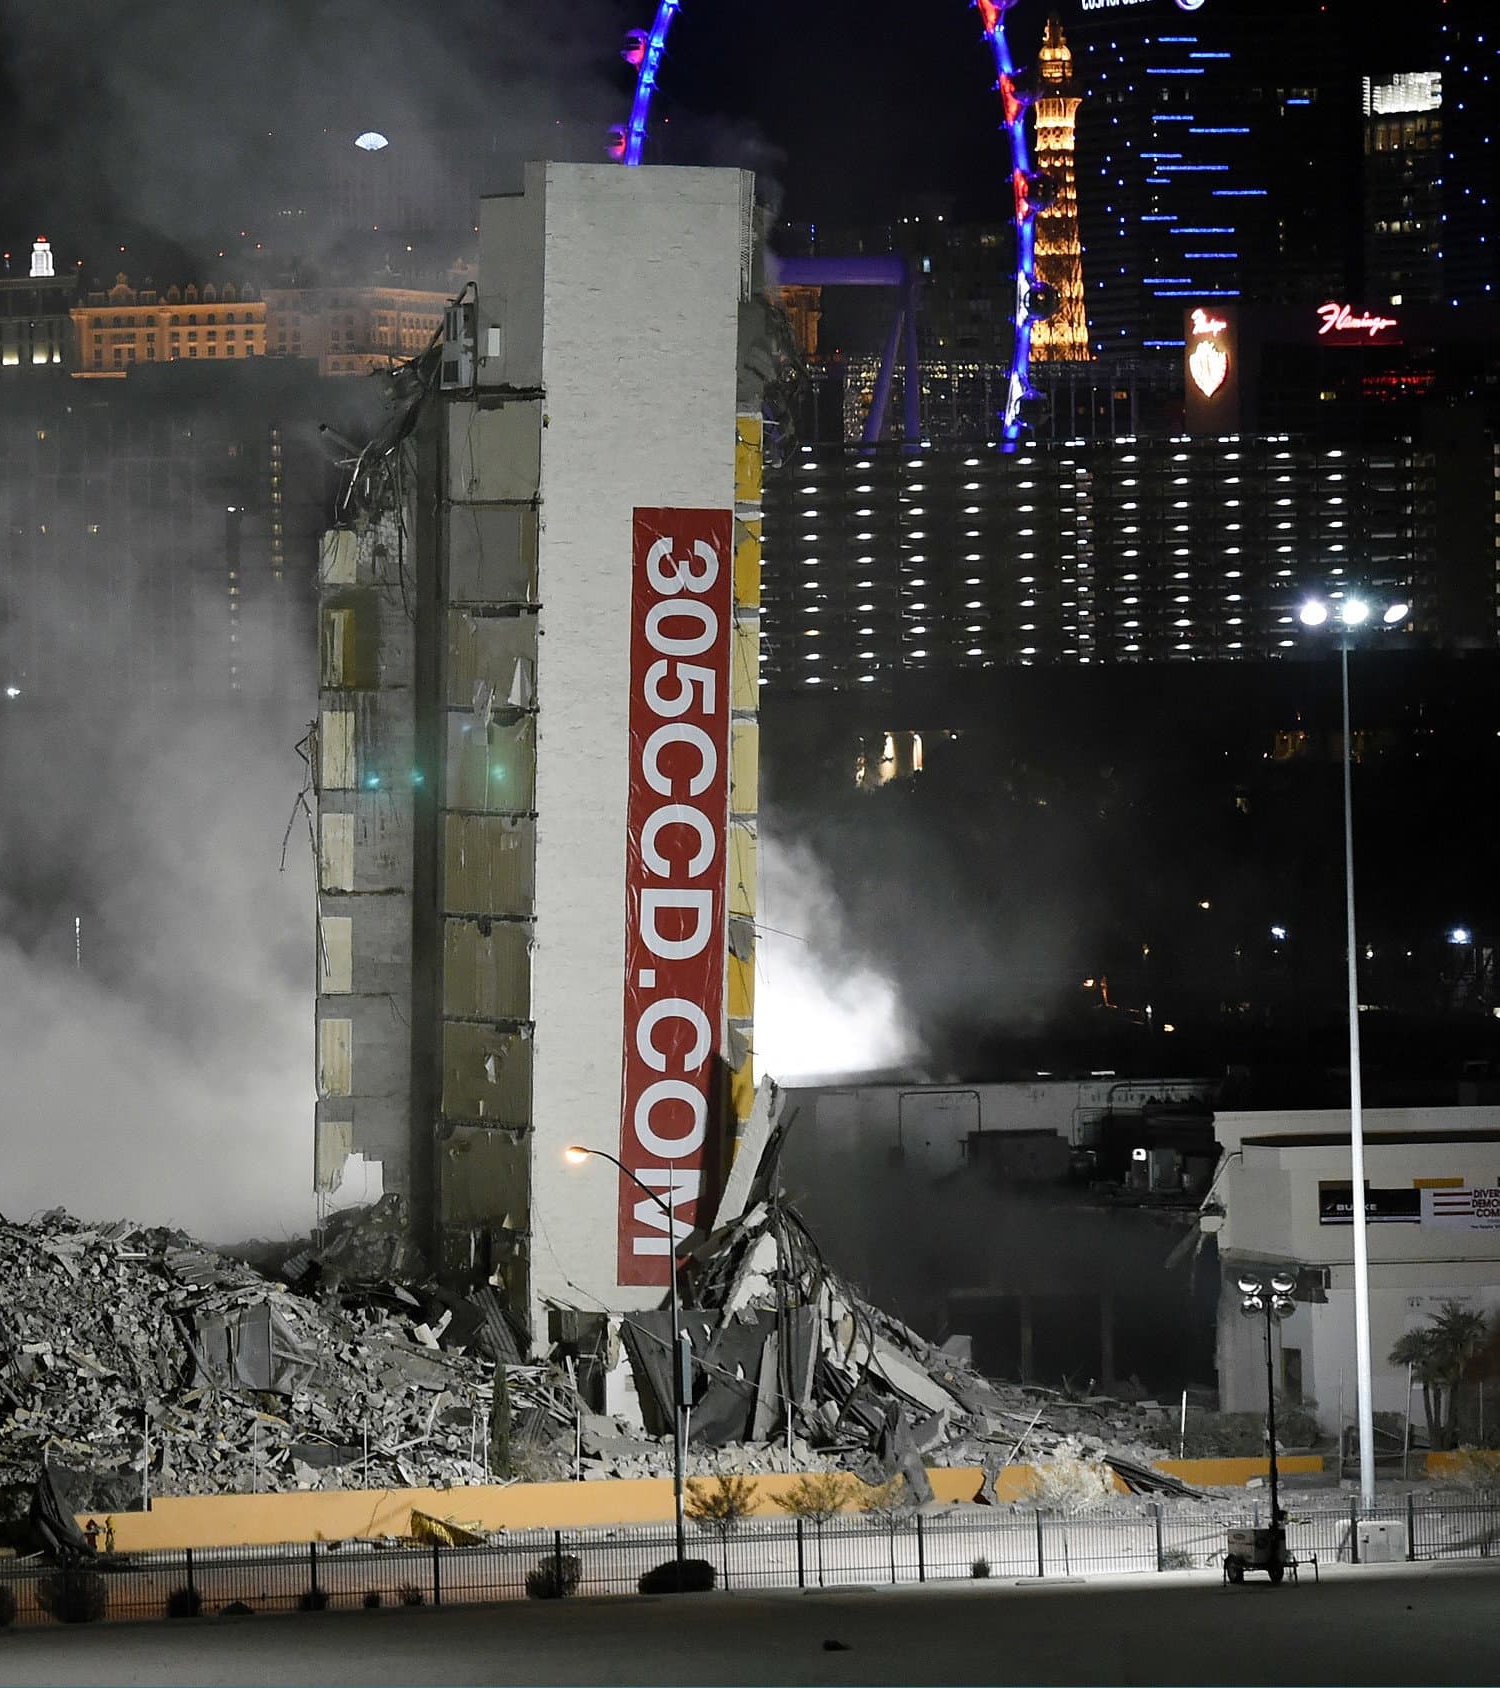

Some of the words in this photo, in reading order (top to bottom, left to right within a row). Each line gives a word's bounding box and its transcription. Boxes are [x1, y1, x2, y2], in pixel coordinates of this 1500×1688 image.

[1316, 303, 1397, 336] Flamingo
[632, 536, 719, 1255] 305CCD.COM
[1336, 1203, 1377, 1211] BUKE
